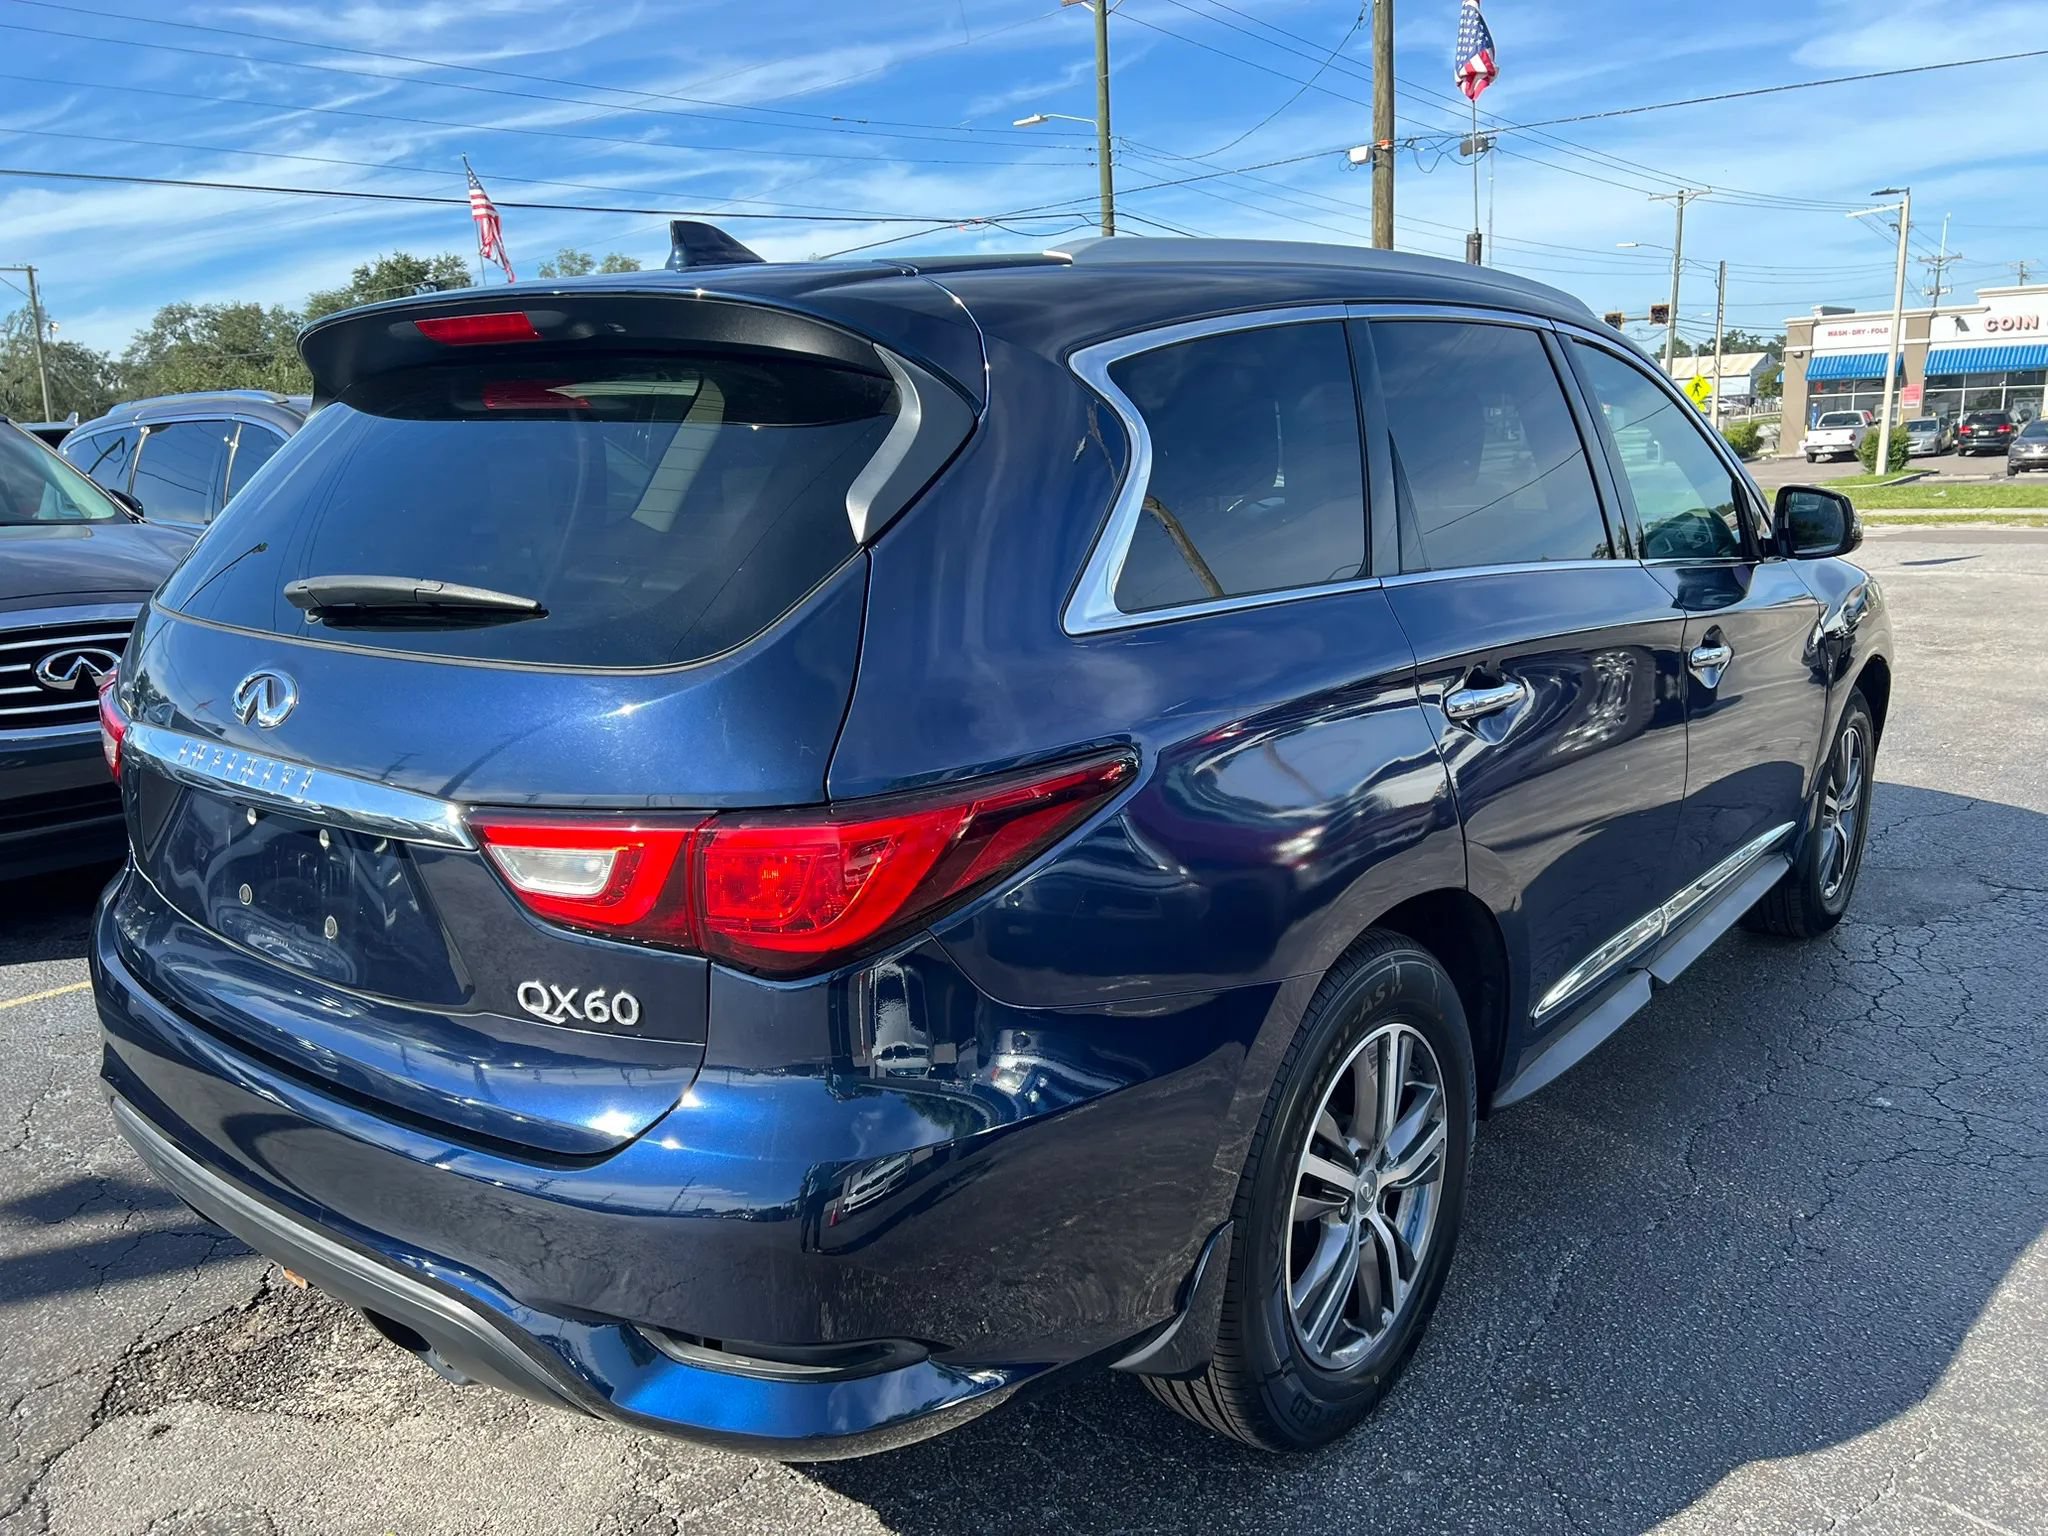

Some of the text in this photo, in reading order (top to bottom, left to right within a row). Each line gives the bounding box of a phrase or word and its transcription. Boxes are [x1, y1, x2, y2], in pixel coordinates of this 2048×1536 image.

[1852, 328, 1866, 336] DRY
[1871, 327, 1889, 335] FOLD
[1984, 315, 2039, 333] COIN
[177, 740, 316, 795] INFINITI
[517, 979, 640, 1026] QX60
